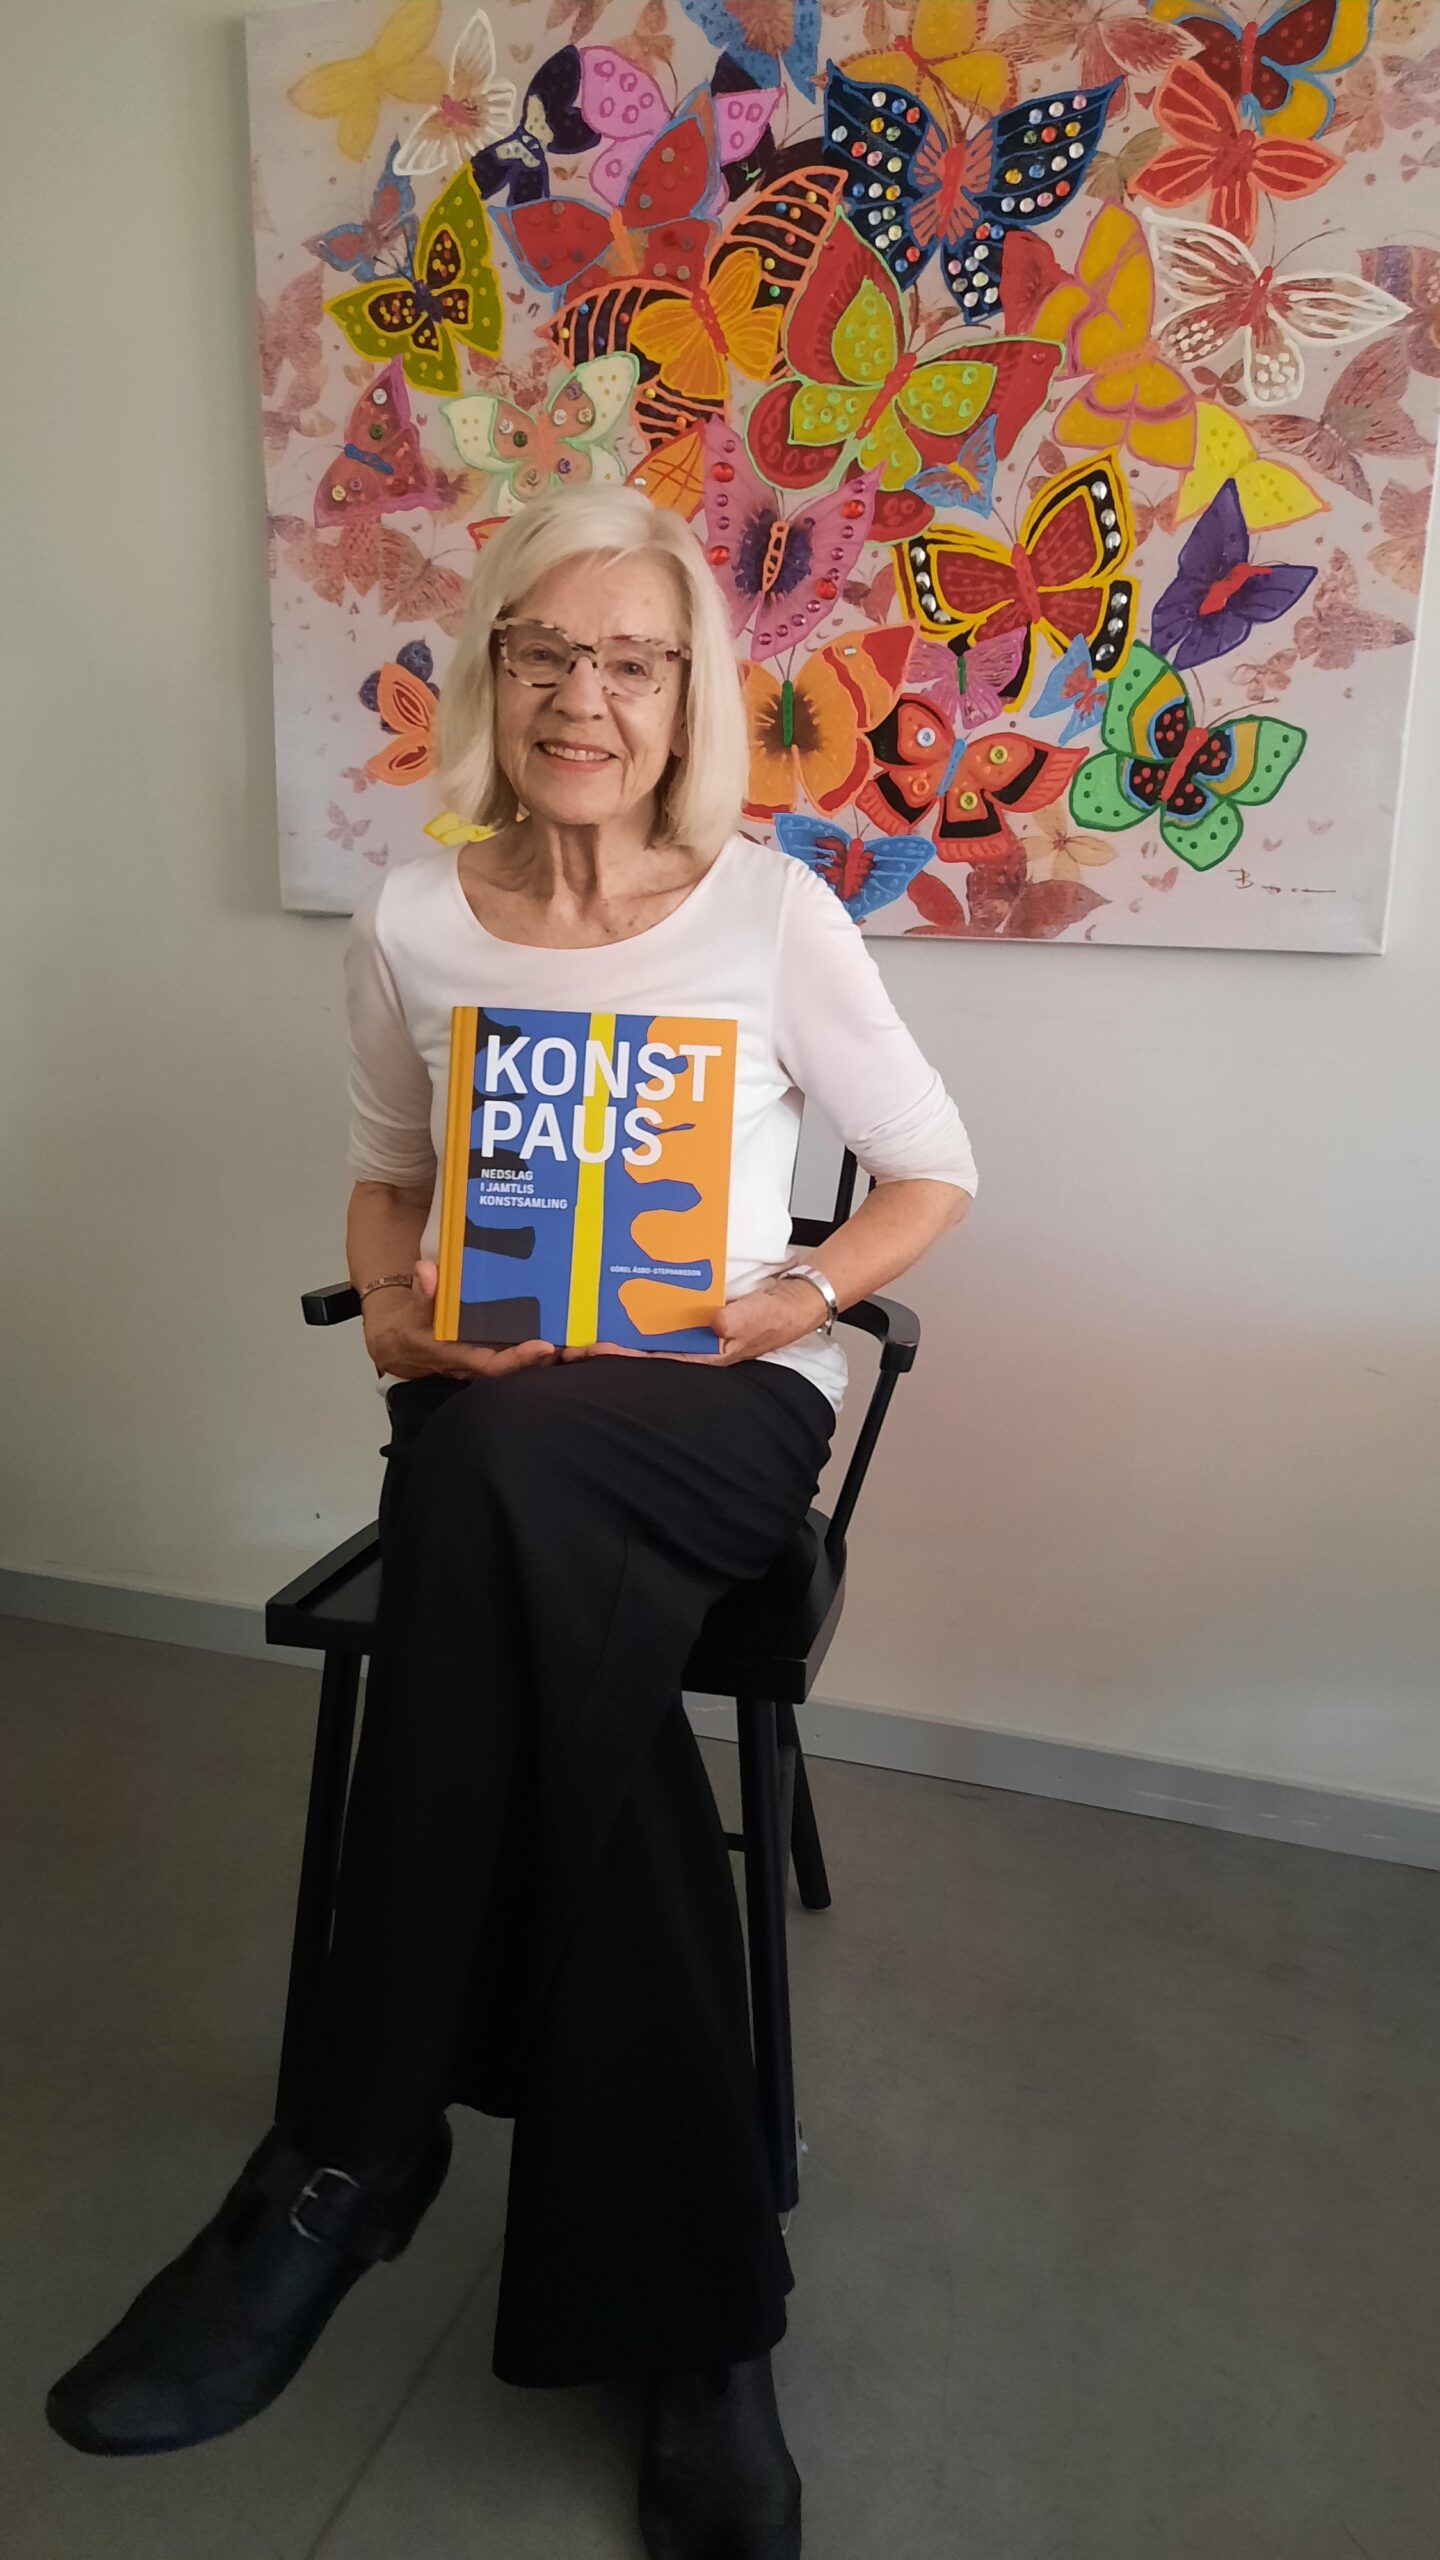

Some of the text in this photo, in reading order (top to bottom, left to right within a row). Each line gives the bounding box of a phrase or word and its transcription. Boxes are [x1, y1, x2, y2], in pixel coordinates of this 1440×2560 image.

[484, 1034, 723, 1103] KONST
[481, 1099, 664, 1166] PAUS
[480, 1168, 534, 1181] NEDSLAG
[480, 1181, 535, 1195] I JAMTLIS
[479, 1195, 569, 1210] KONSTSAMLING
